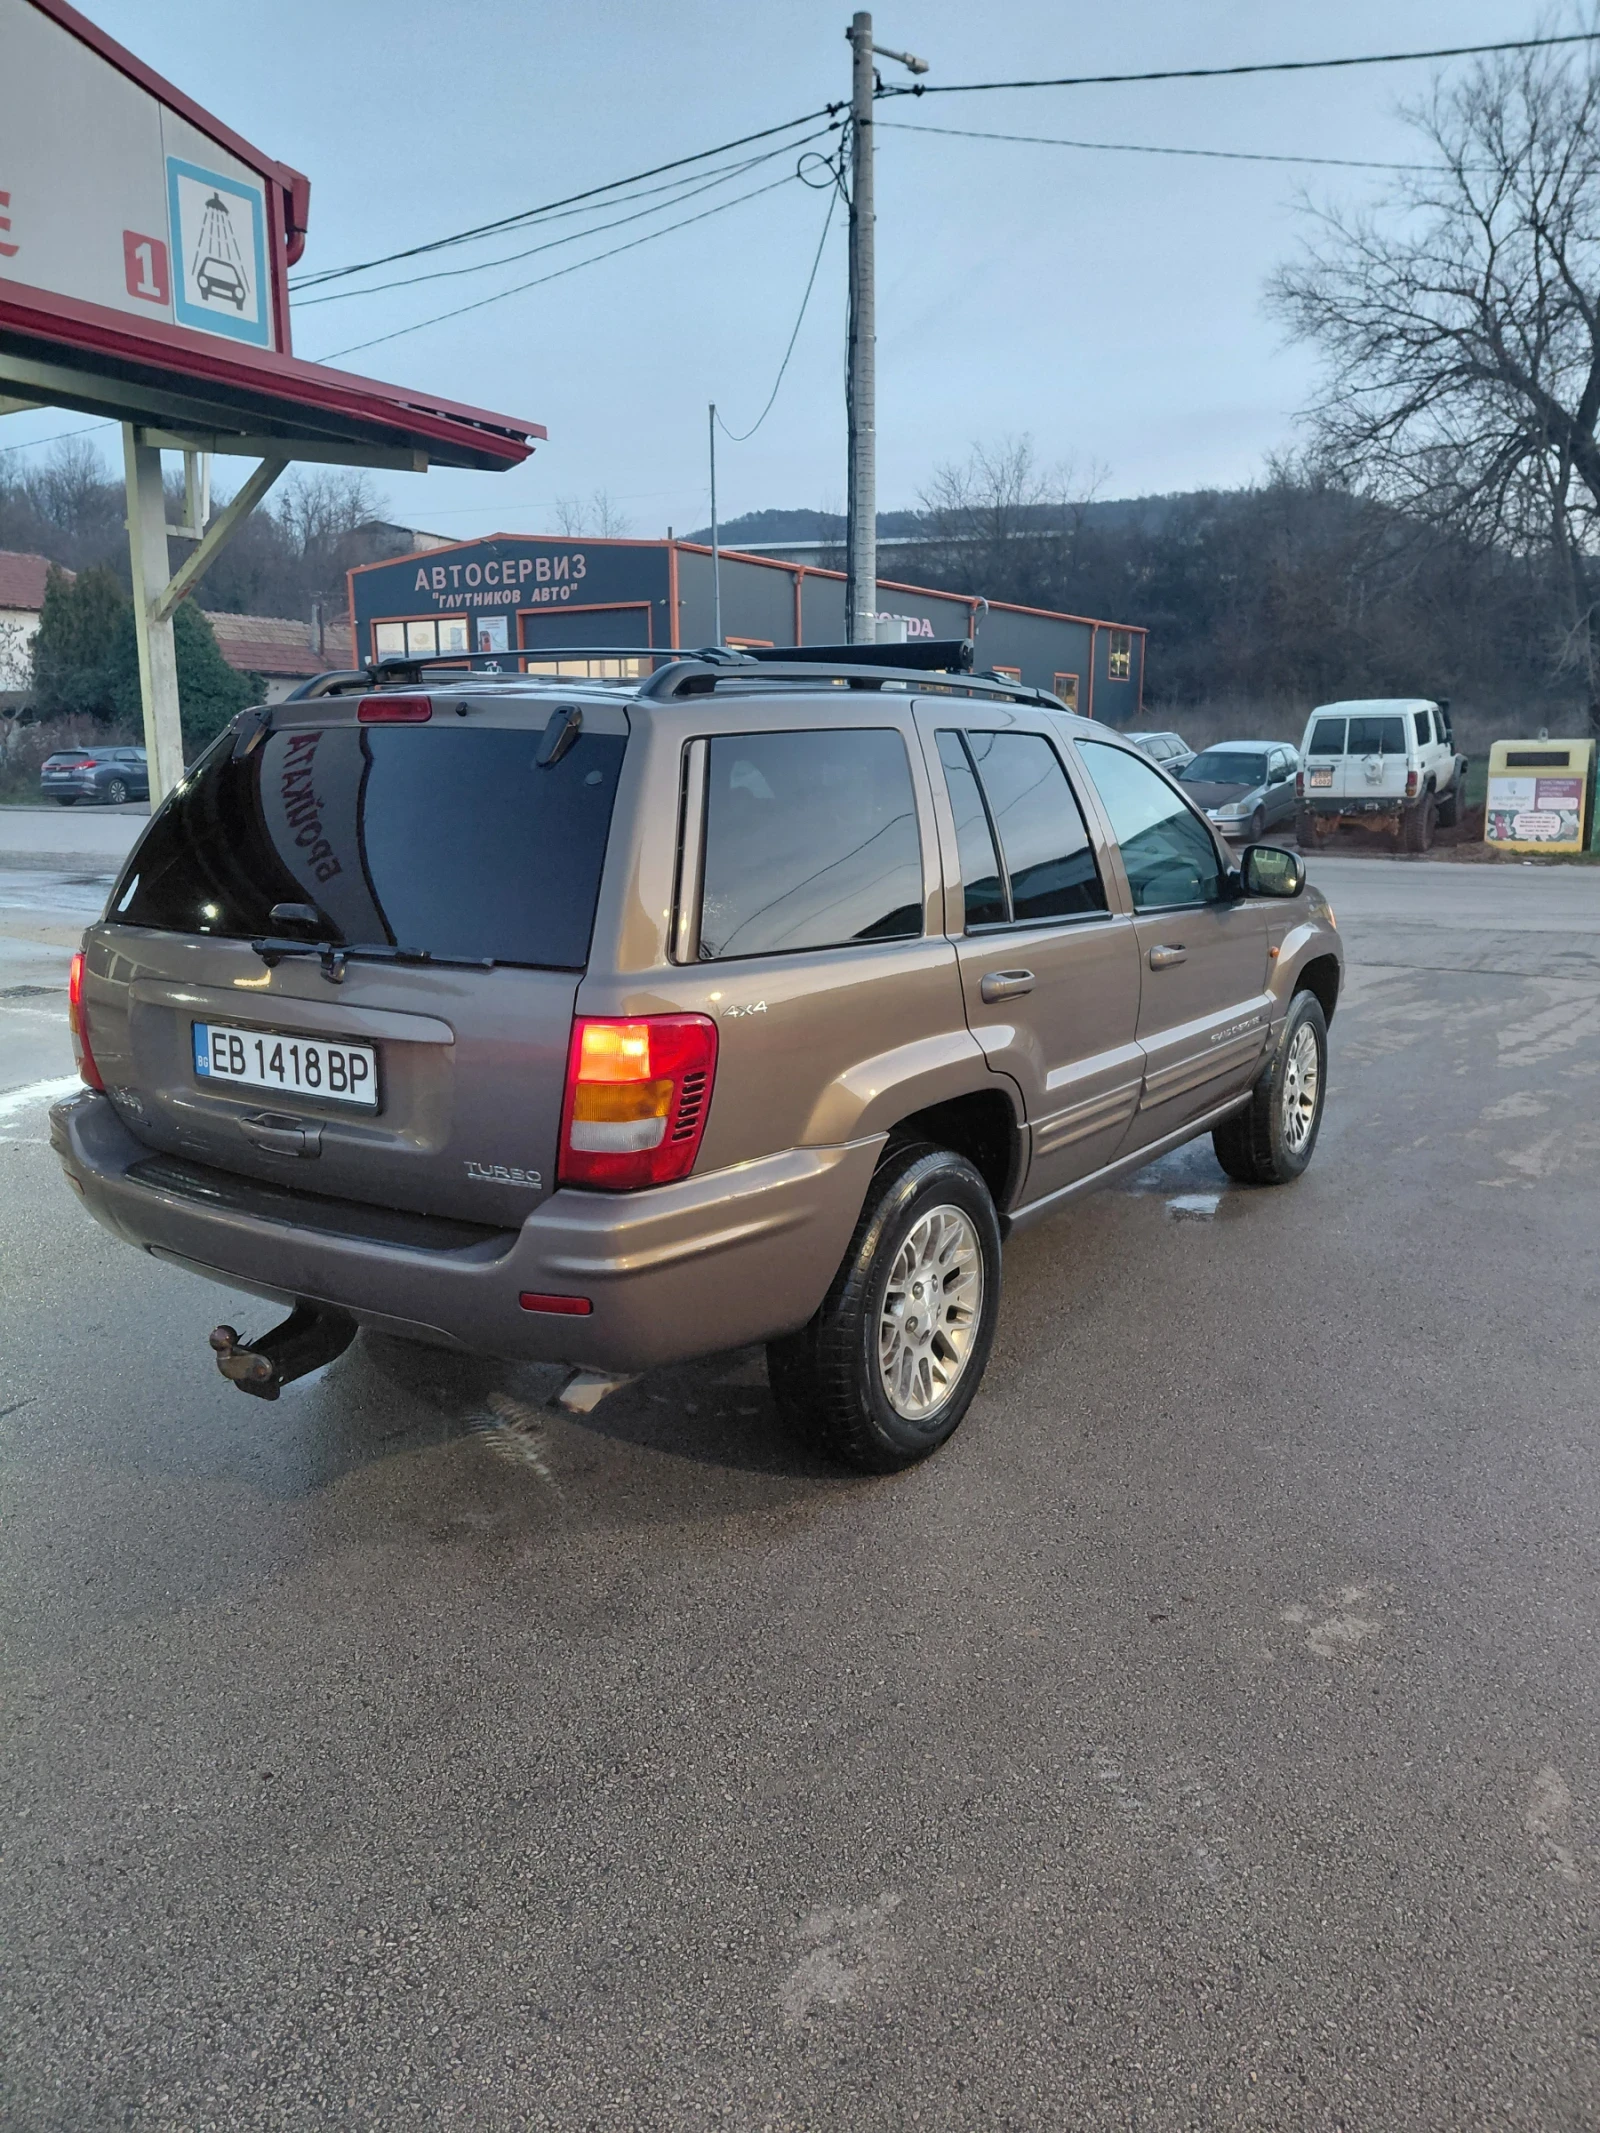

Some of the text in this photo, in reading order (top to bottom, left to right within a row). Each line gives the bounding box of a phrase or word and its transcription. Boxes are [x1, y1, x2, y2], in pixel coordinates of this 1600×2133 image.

[135, 242, 161, 298] 1
[414, 553, 587, 592] АВТОСЕРВИЗ
[531, 583, 578, 602] АВТО"
[197, 1055, 209, 1068] BG
[211, 1032, 368, 1094] EB 1418 BP
[463, 1161, 542, 1182] TURBO
